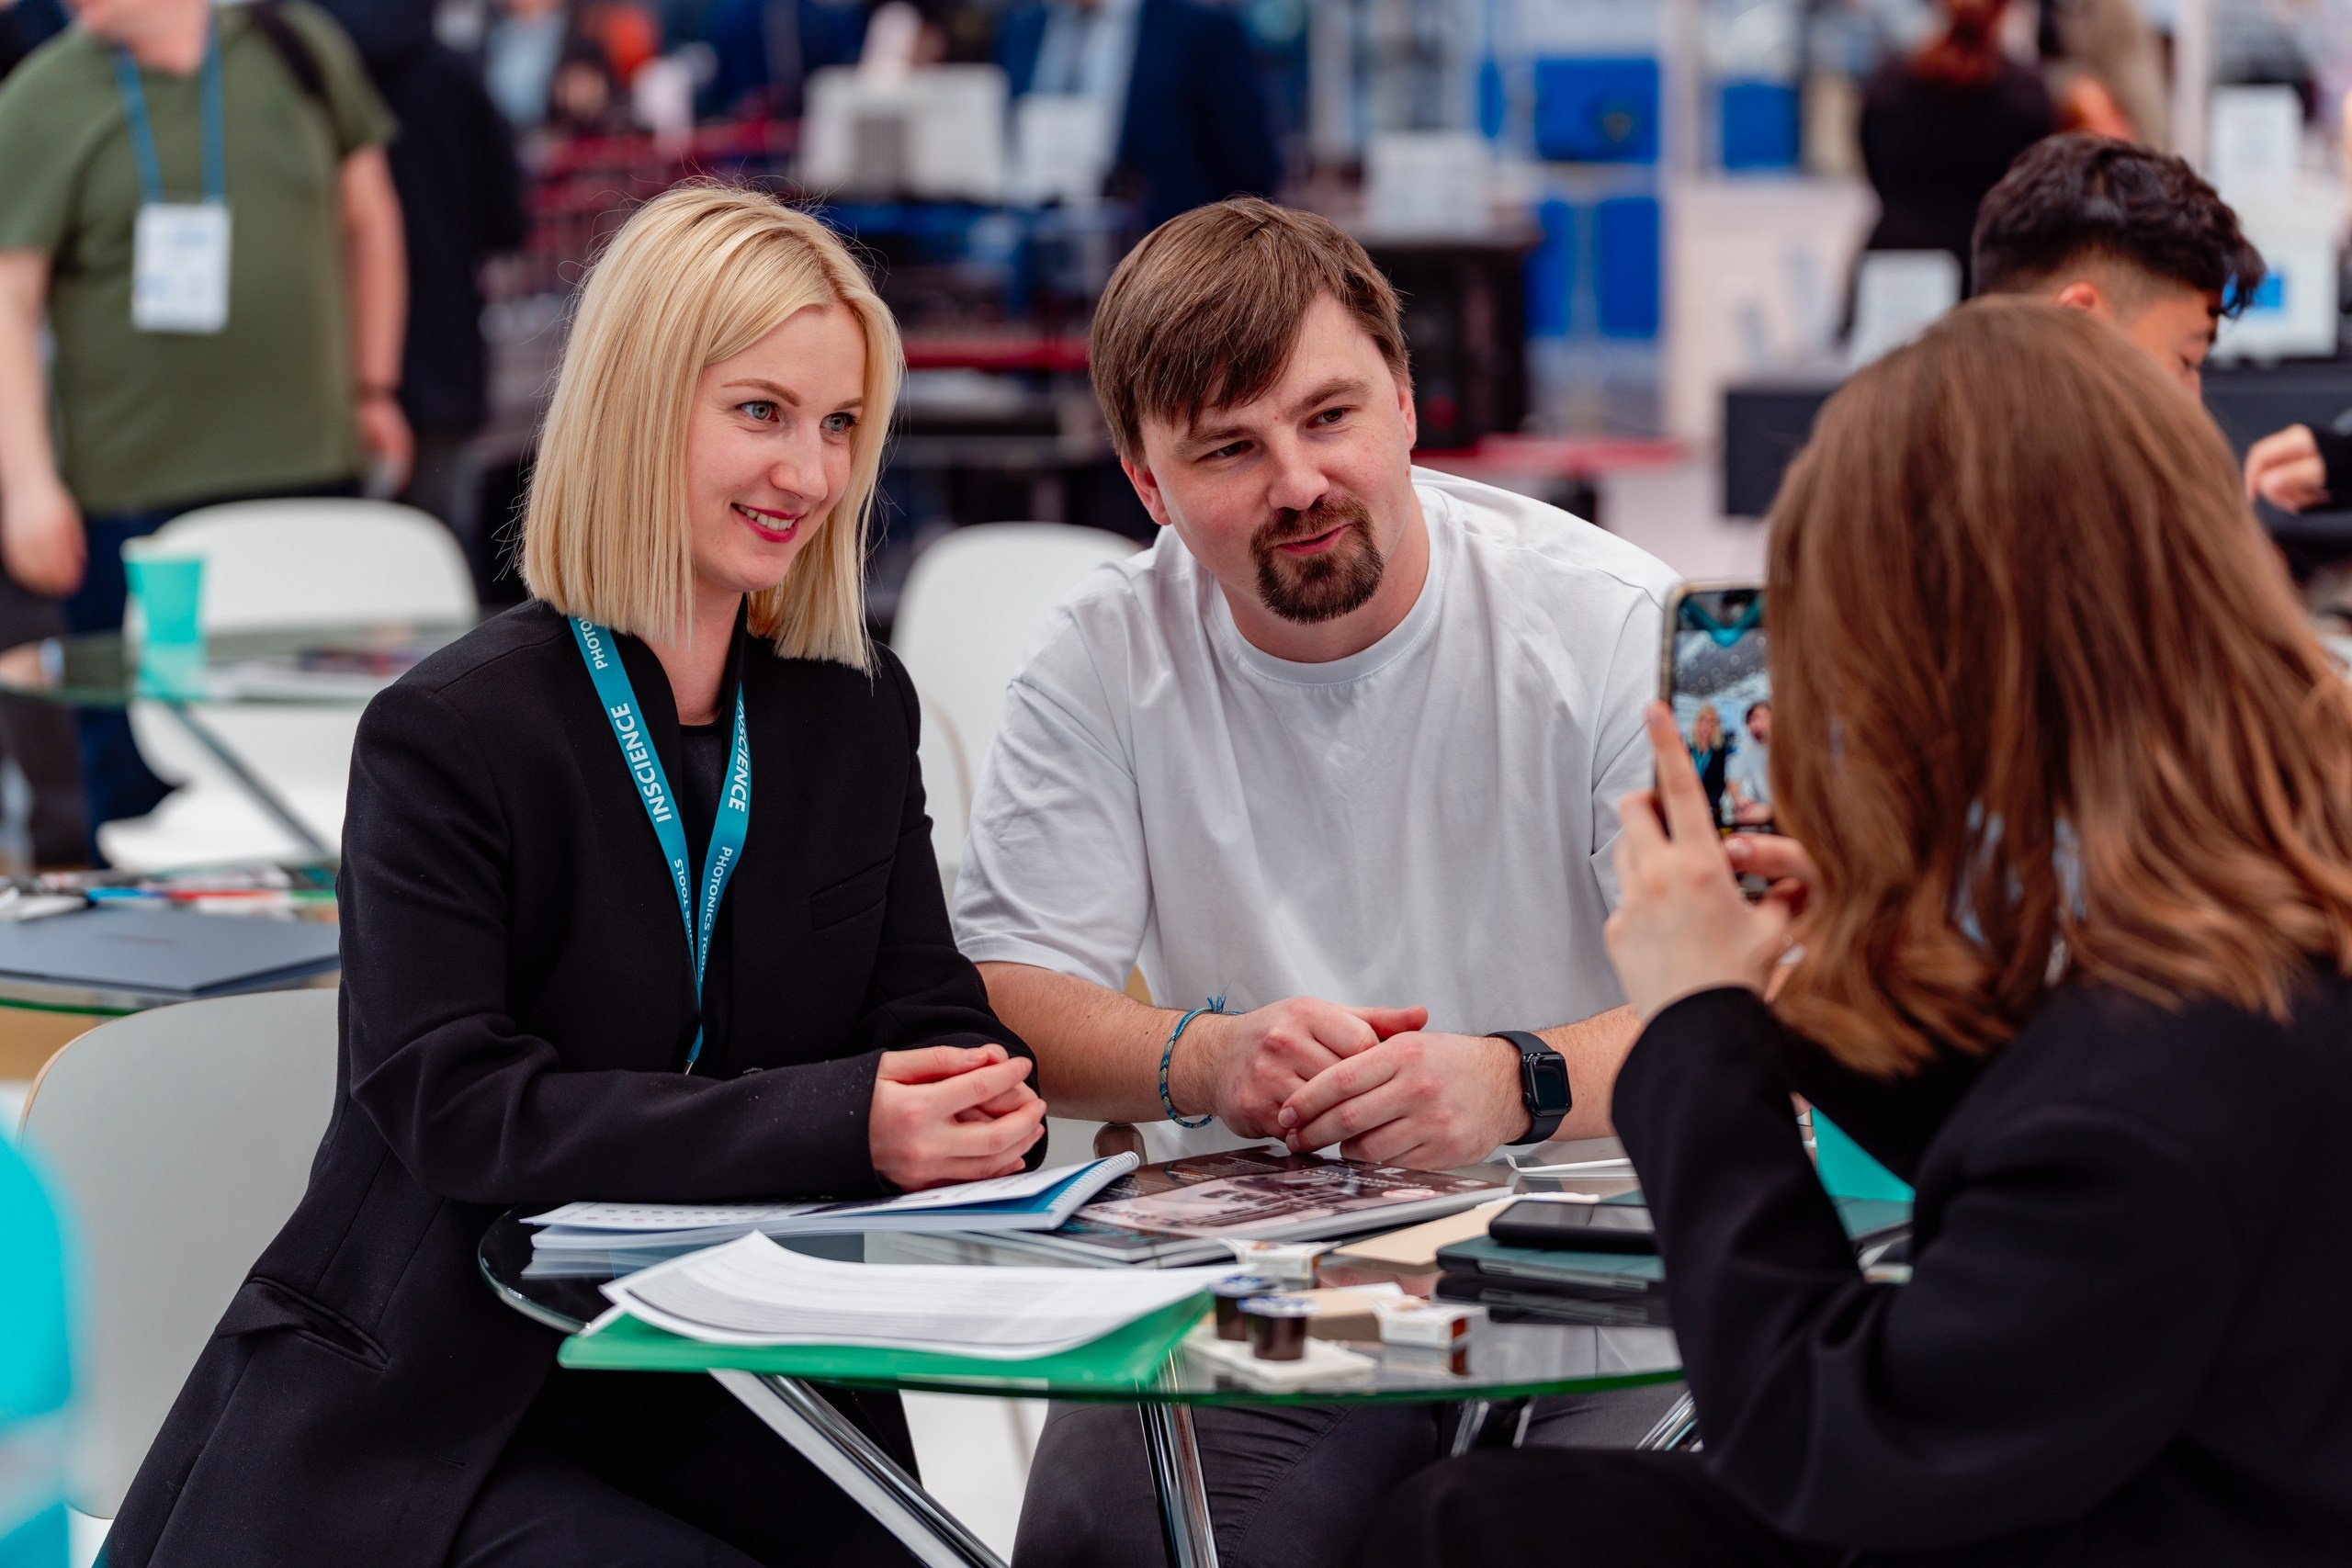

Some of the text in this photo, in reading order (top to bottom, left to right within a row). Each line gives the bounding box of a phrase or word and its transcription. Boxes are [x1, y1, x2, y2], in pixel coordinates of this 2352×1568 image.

[578, 617, 608, 670] PHOTO
[610, 703, 673, 823] INSCIENCE
[729, 699, 749, 812] INSCIENCE
[673, 858, 689, 908] TOOLS
[704, 846, 733, 931] PHOTONICS
